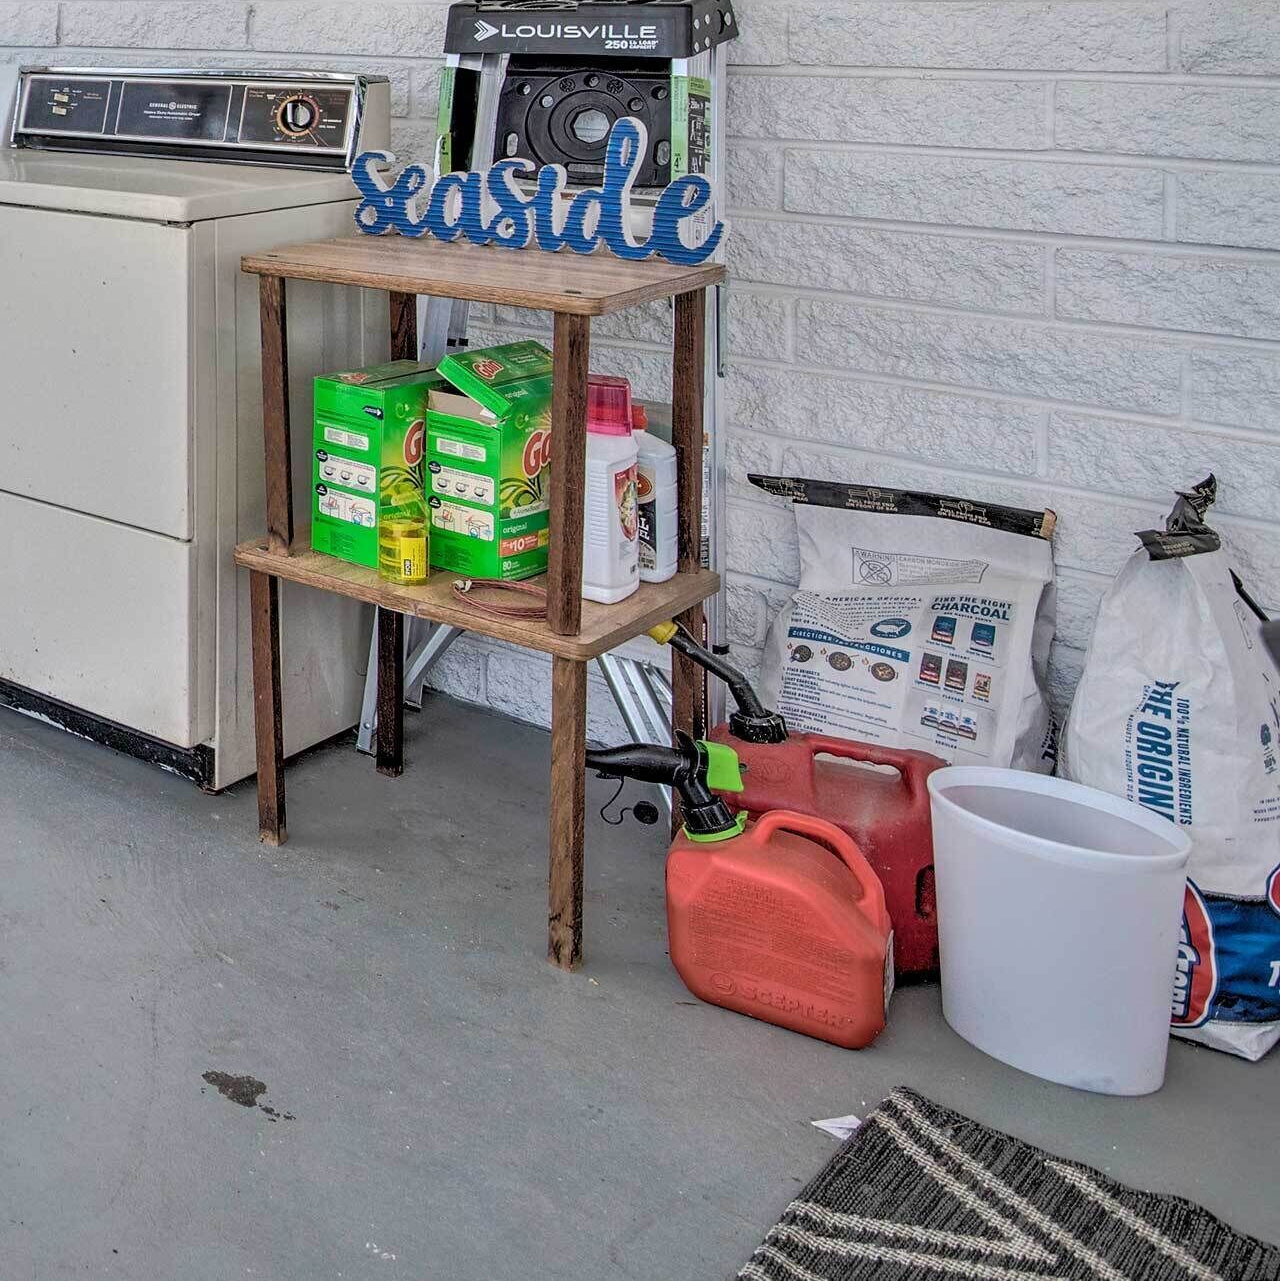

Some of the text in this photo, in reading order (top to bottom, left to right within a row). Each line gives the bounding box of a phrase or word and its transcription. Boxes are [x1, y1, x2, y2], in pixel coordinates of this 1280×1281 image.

[501, 24, 657, 39] LOUISVILLE
[605, 40, 628, 50] 250
[351, 116, 731, 267] seaside
[522, 429, 552, 479] Ga
[502, 522, 528, 534] original
[861, 551, 896, 563] WARNING
[959, 596, 977, 604] THE
[981, 599, 1013, 610] RIGHT
[931, 603, 1010, 622] CHARCOAL
[792, 630, 832, 643] DIRECTIONS
[1140, 680, 1180, 720] THE
[1176, 697, 1192, 826] 100% NATURAL INGREDIENTS
